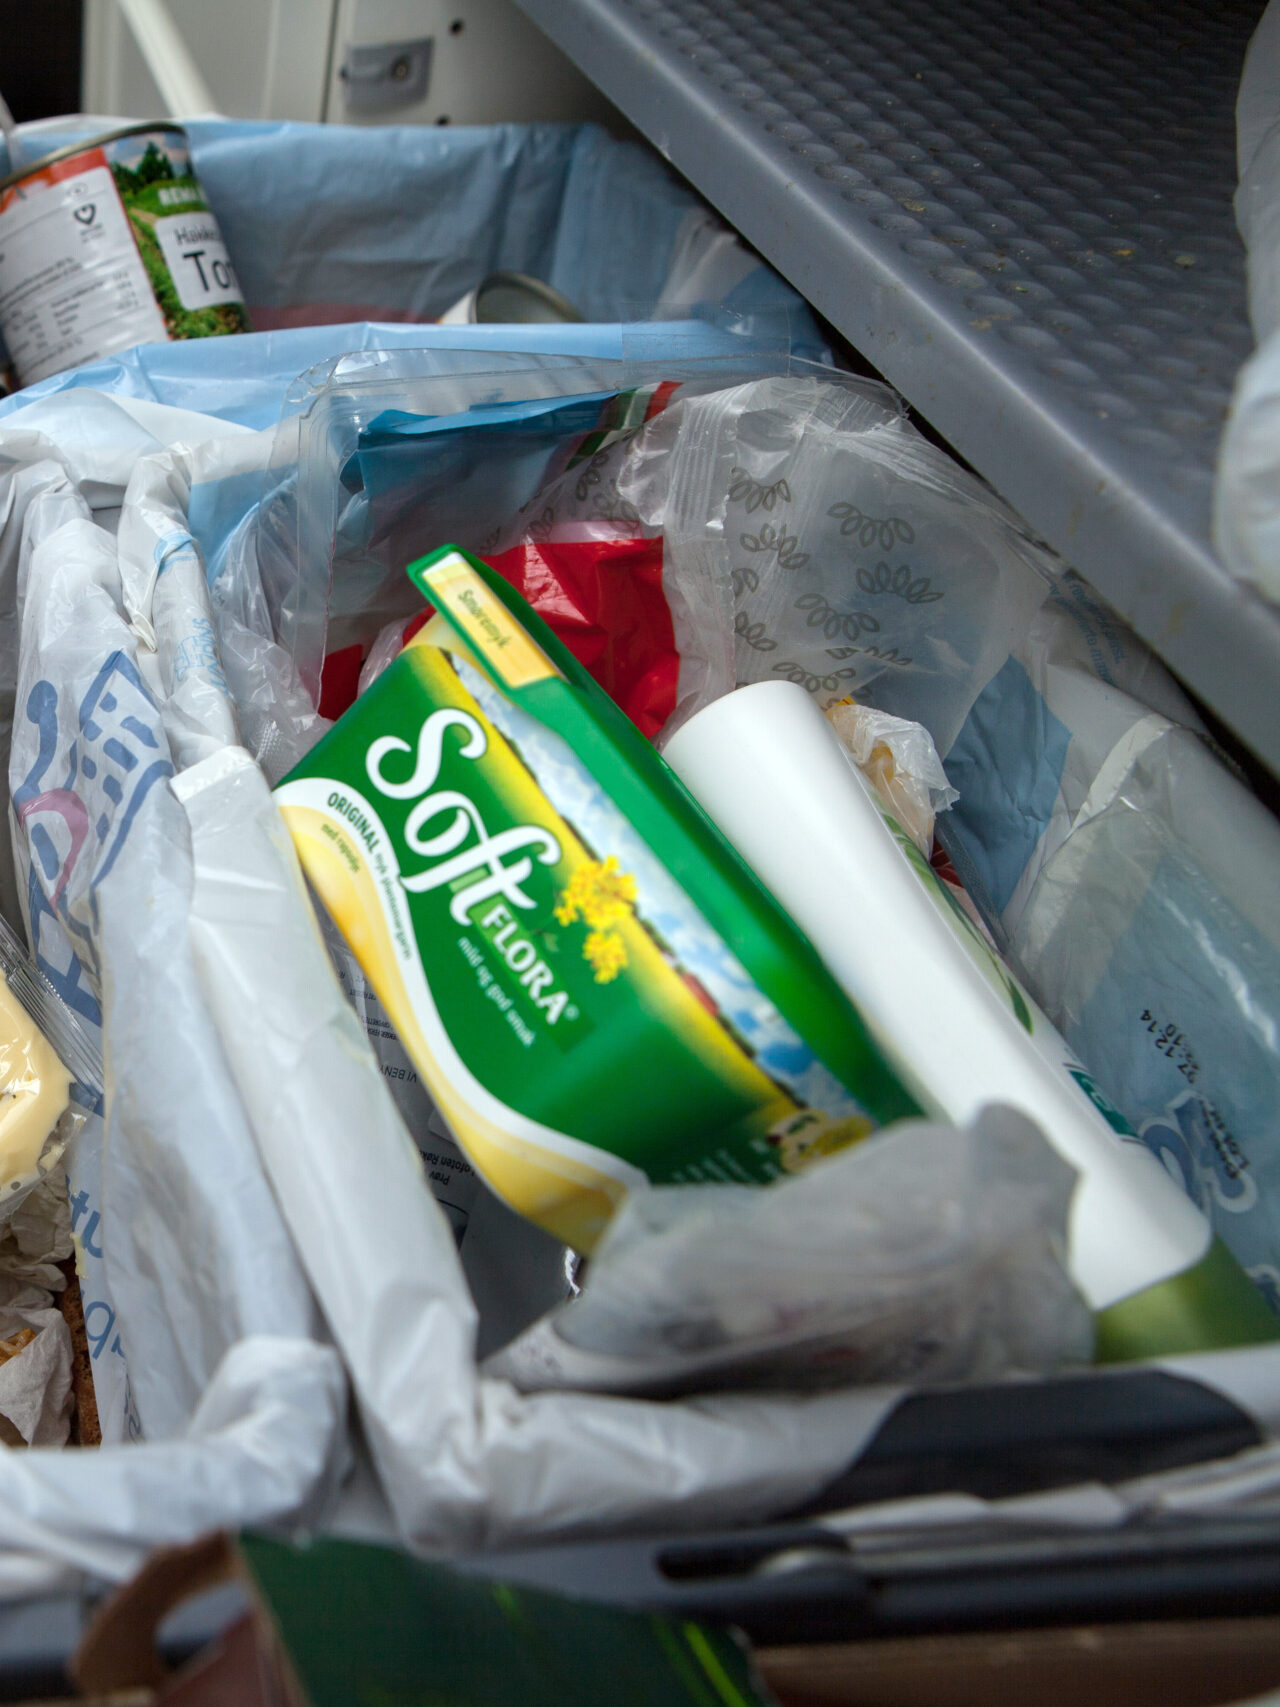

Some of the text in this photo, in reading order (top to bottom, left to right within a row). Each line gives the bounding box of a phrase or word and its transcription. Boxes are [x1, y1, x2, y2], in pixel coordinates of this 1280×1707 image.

[326, 791, 380, 855] ORIGINAL
[366, 708, 562, 926] Soft
[458, 936, 536, 1047] mild og god smak
[483, 902, 568, 1024] FLORA
[440, 1156, 476, 1177] ofoten
